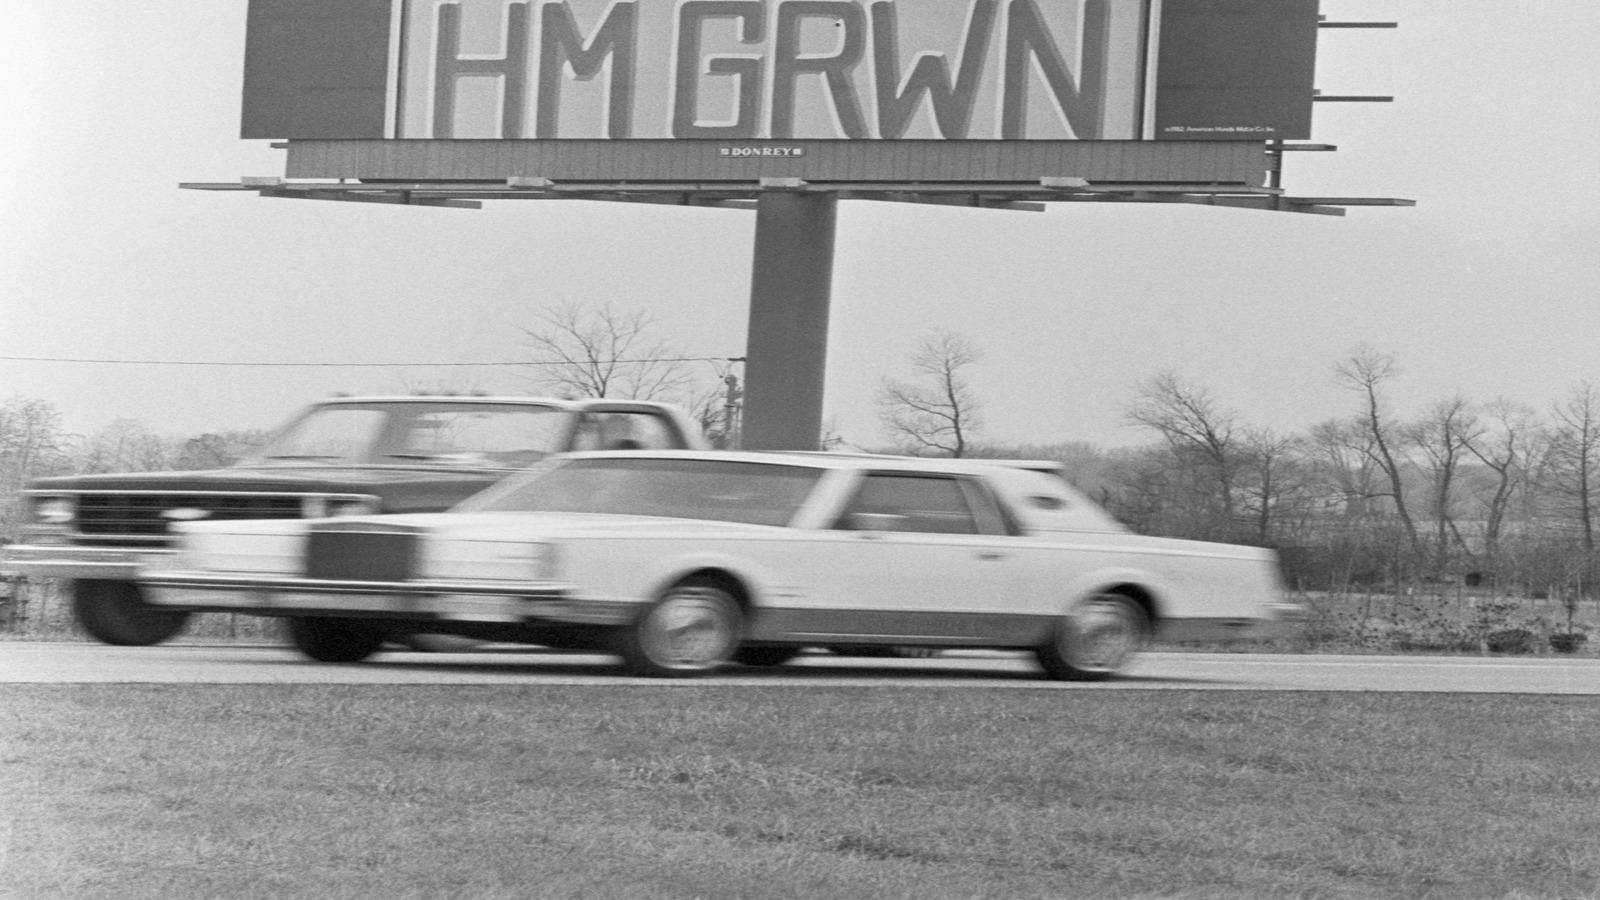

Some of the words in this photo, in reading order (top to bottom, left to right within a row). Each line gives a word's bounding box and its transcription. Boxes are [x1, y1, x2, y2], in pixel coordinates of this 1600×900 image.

[428, 0, 640, 139] HM
[668, 0, 1110, 139] GRWN
[731, 147, 791, 156] DONREY
